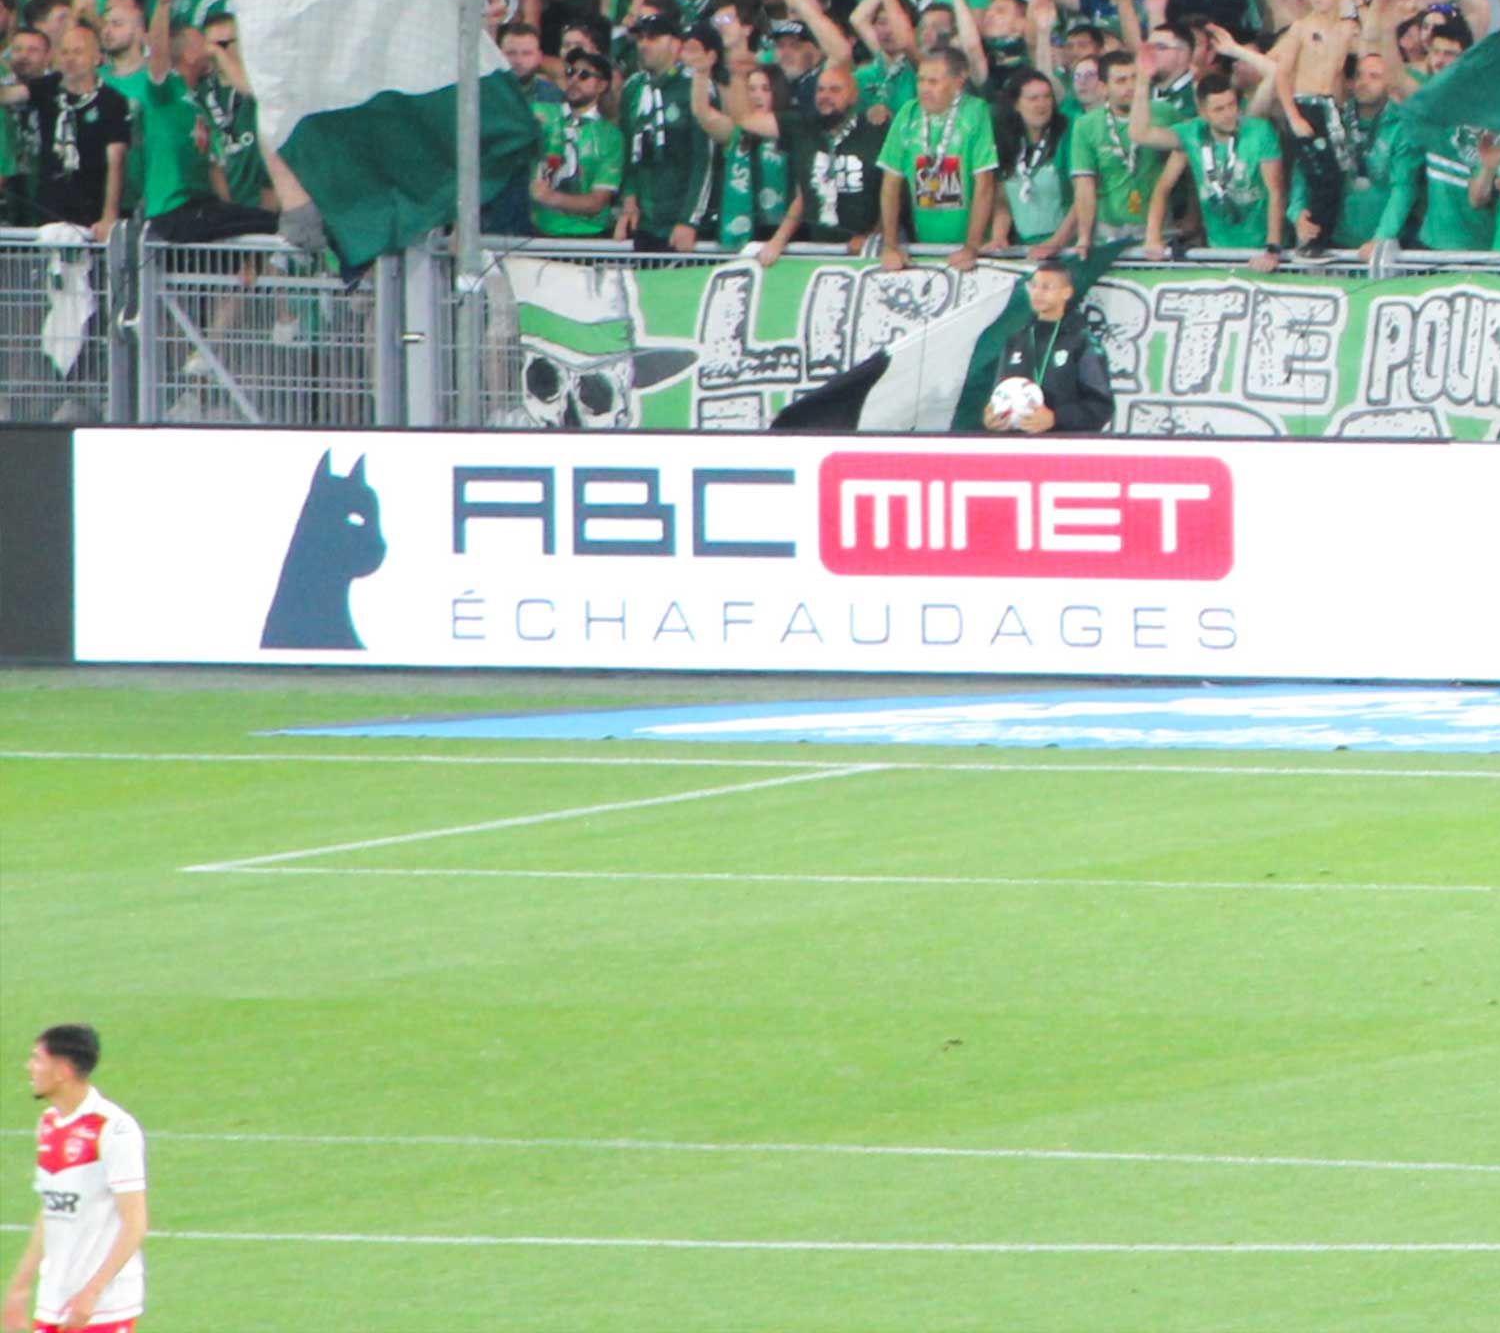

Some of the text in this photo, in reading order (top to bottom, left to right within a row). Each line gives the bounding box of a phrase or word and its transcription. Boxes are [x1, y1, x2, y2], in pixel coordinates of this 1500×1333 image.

[452, 465, 1211, 559] ABC MINET
[452, 589, 1239, 652] ÉCHAFAUDAGES
